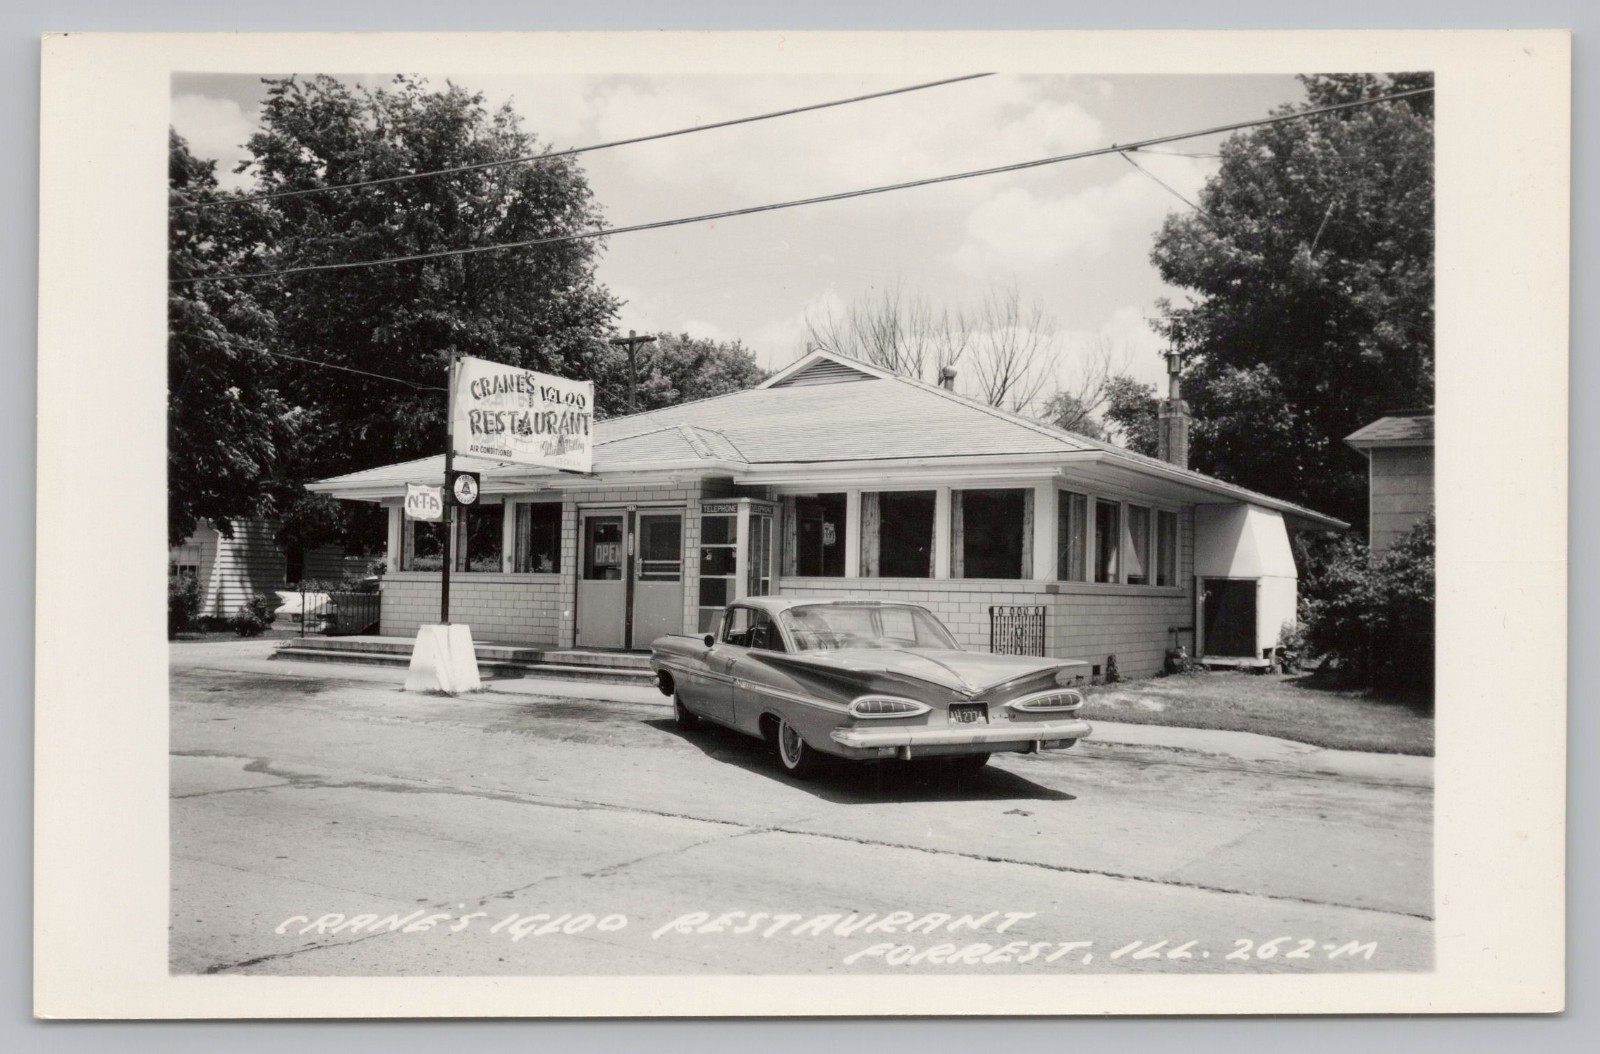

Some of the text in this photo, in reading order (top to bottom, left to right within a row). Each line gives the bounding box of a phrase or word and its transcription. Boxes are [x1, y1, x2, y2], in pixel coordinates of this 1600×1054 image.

[470, 371, 536, 400] CRANE'S
[540, 386, 586, 410] IGLOO
[468, 409, 592, 436] RESTAURANT
[470, 444, 513, 457] AIR CONDITIONED
[703, 504, 737, 513] TELEPHONE
[595, 544, 622, 563] OPEN
